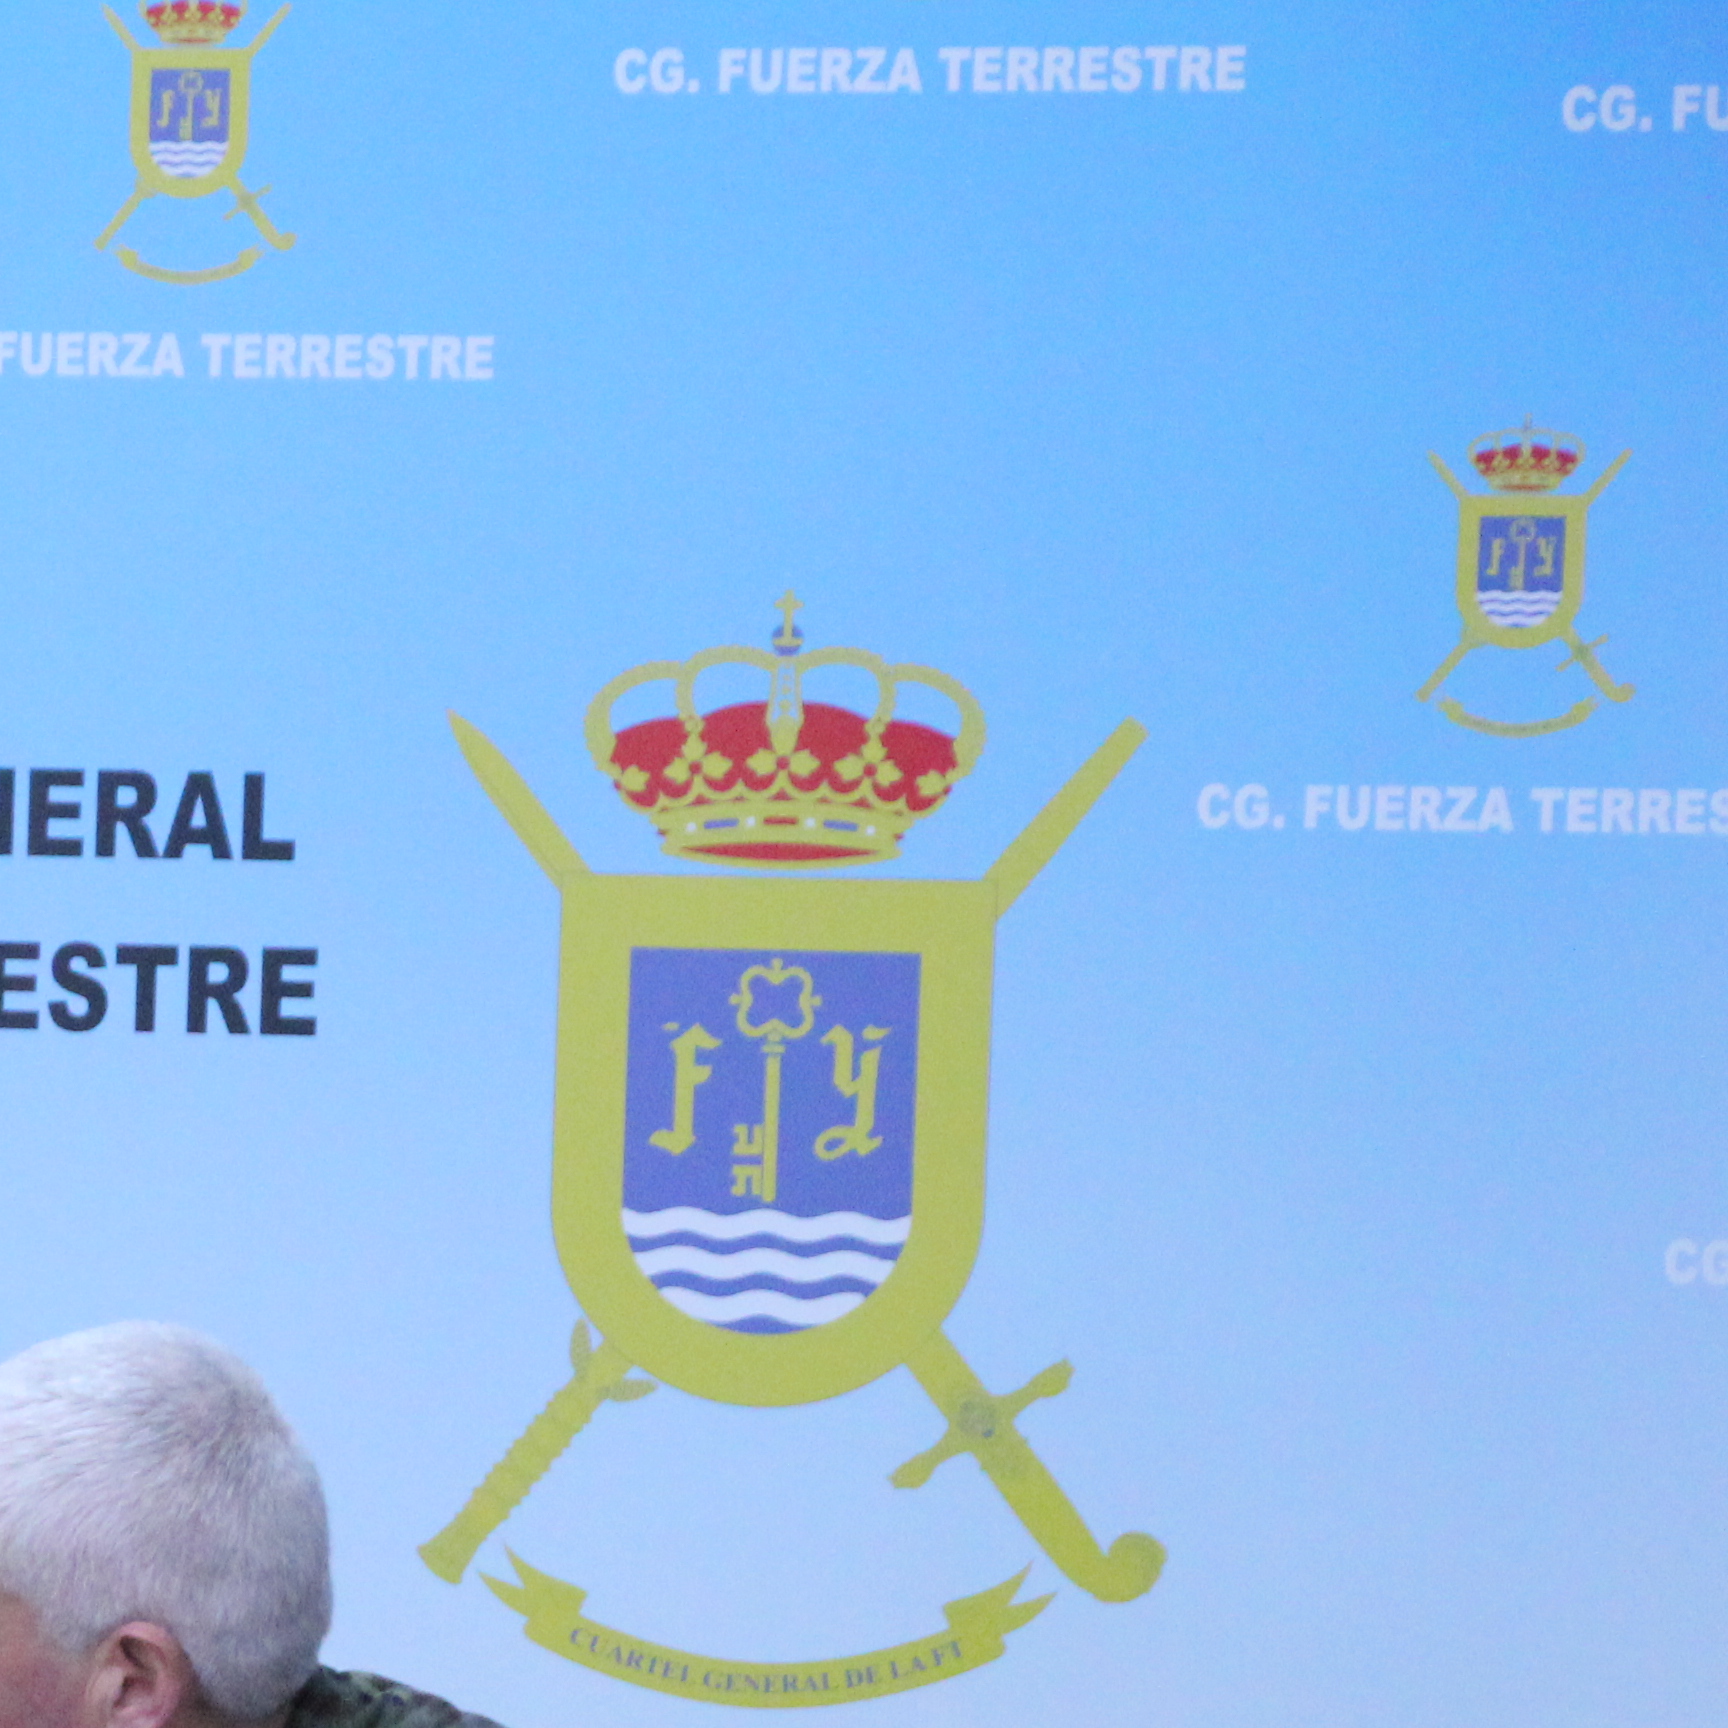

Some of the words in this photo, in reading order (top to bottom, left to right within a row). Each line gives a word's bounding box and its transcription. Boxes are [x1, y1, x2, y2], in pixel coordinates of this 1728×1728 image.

[613, 47, 701, 95] CG.
[717, 46, 922, 95] FUERZA
[938, 44, 1247, 93] TERRESTRE
[1562, 84, 1653, 133] CG.
[200, 332, 496, 381] TERRESTRE
[1195, 782, 1286, 830] CG.
[1303, 784, 1515, 833] FUERZA
